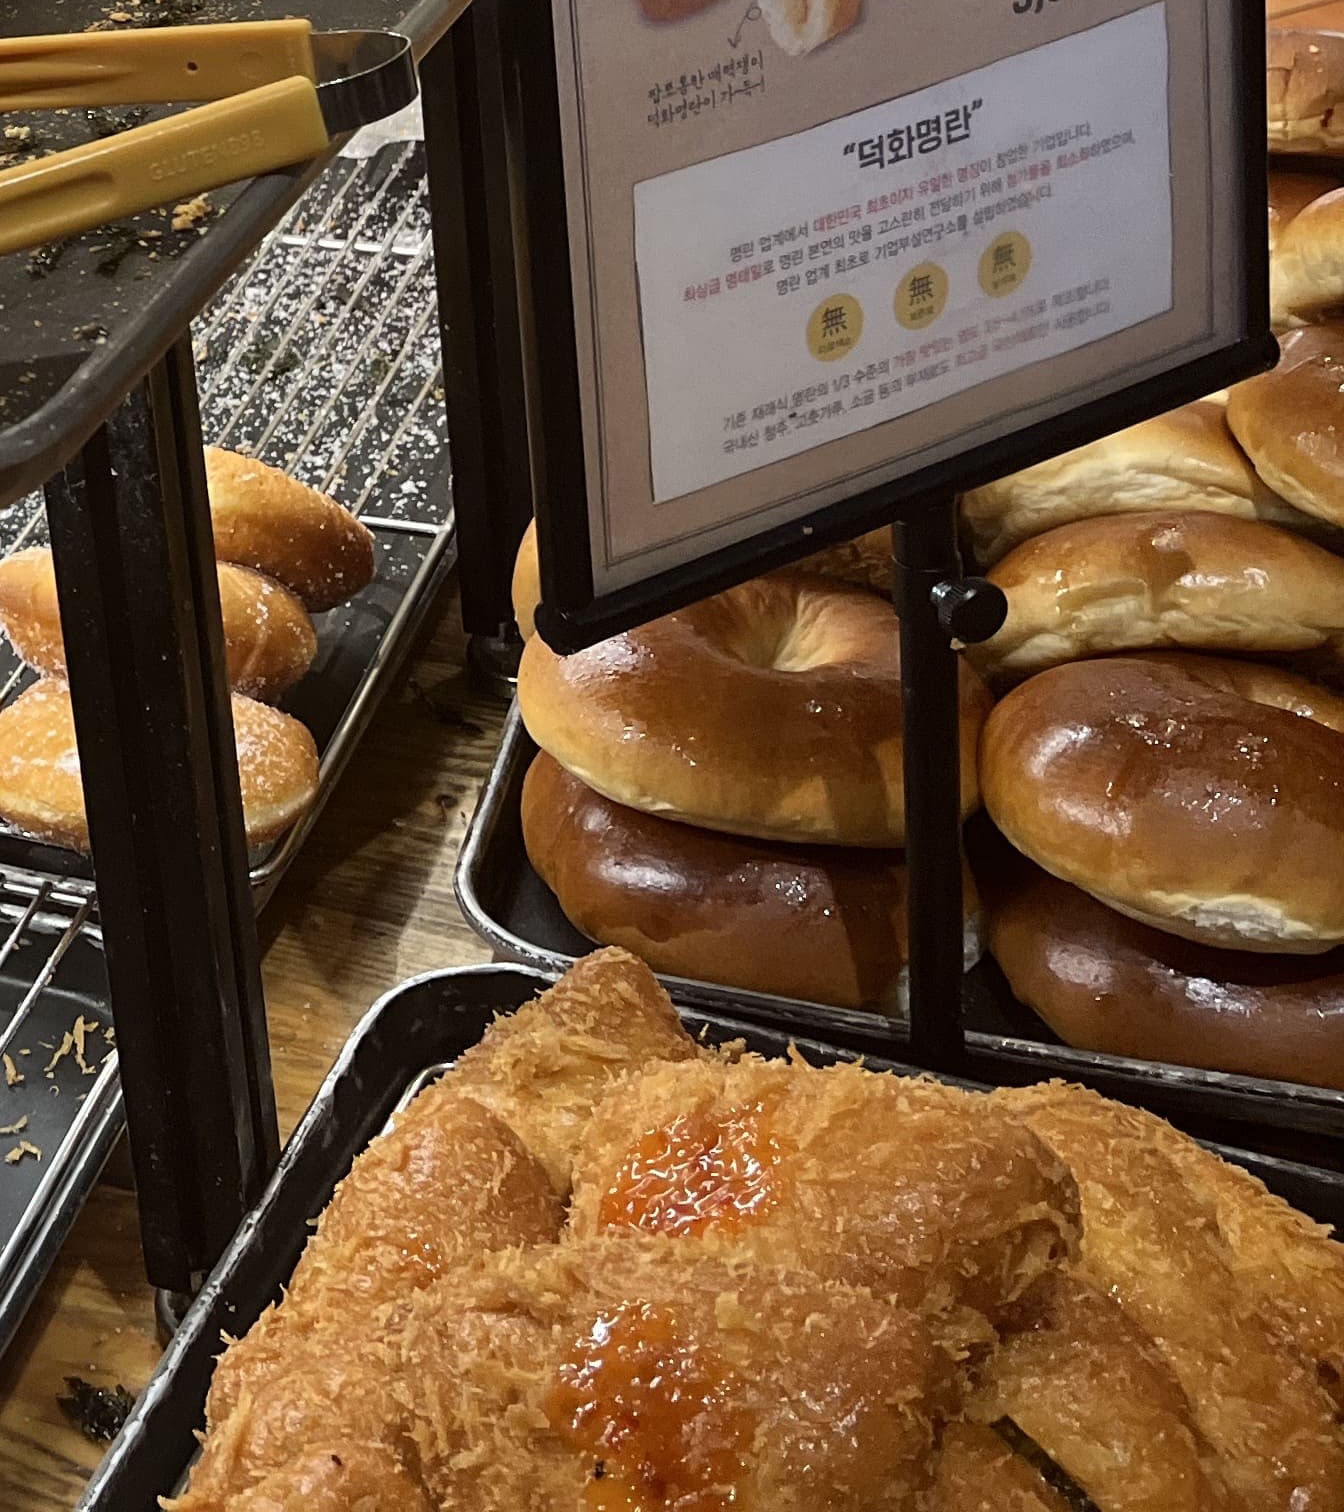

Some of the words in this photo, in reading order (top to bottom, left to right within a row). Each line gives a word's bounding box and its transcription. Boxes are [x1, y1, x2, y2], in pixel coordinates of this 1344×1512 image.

[758, 221, 809, 253] 업계에서
[812, 204, 862, 232] 대한민국
[917, 171, 954, 197] 유일한
[848, 223, 873, 246] 맛을
[876, 207, 926, 235] 고스란히
[929, 188, 977, 217] 전달하기
[775, 273, 801, 297] 명란
[804, 263, 830, 286] 업계
[834, 250, 872, 275] 최초로
[909, 274, 935, 306] 無
[821, 305, 849, 338] 無
[833, 373, 851, 392] 1/3
[854, 359, 890, 385] 수준의
